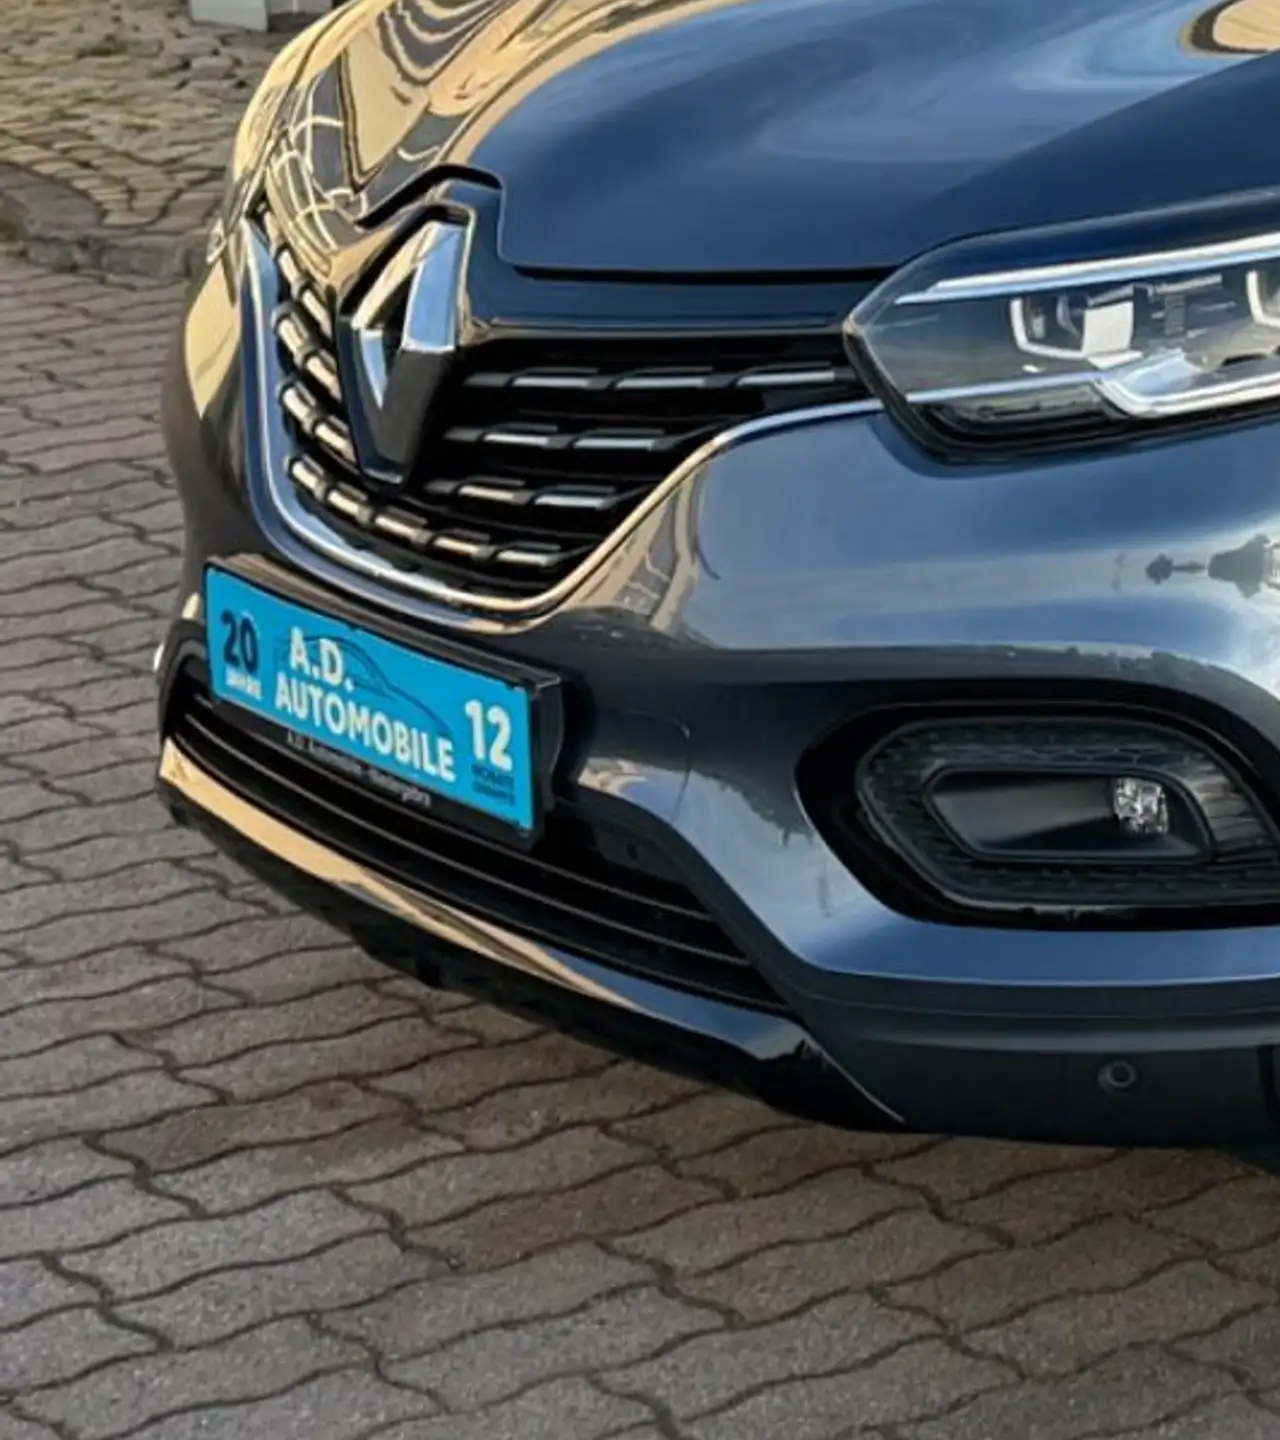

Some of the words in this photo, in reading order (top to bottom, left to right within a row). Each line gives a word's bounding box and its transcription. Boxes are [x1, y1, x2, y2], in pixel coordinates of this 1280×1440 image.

[221, 610, 260, 675] 20
[290, 626, 355, 692] A.D.
[275, 672, 456, 783] AUTOMOBILE
[465, 699, 513, 772] 12
